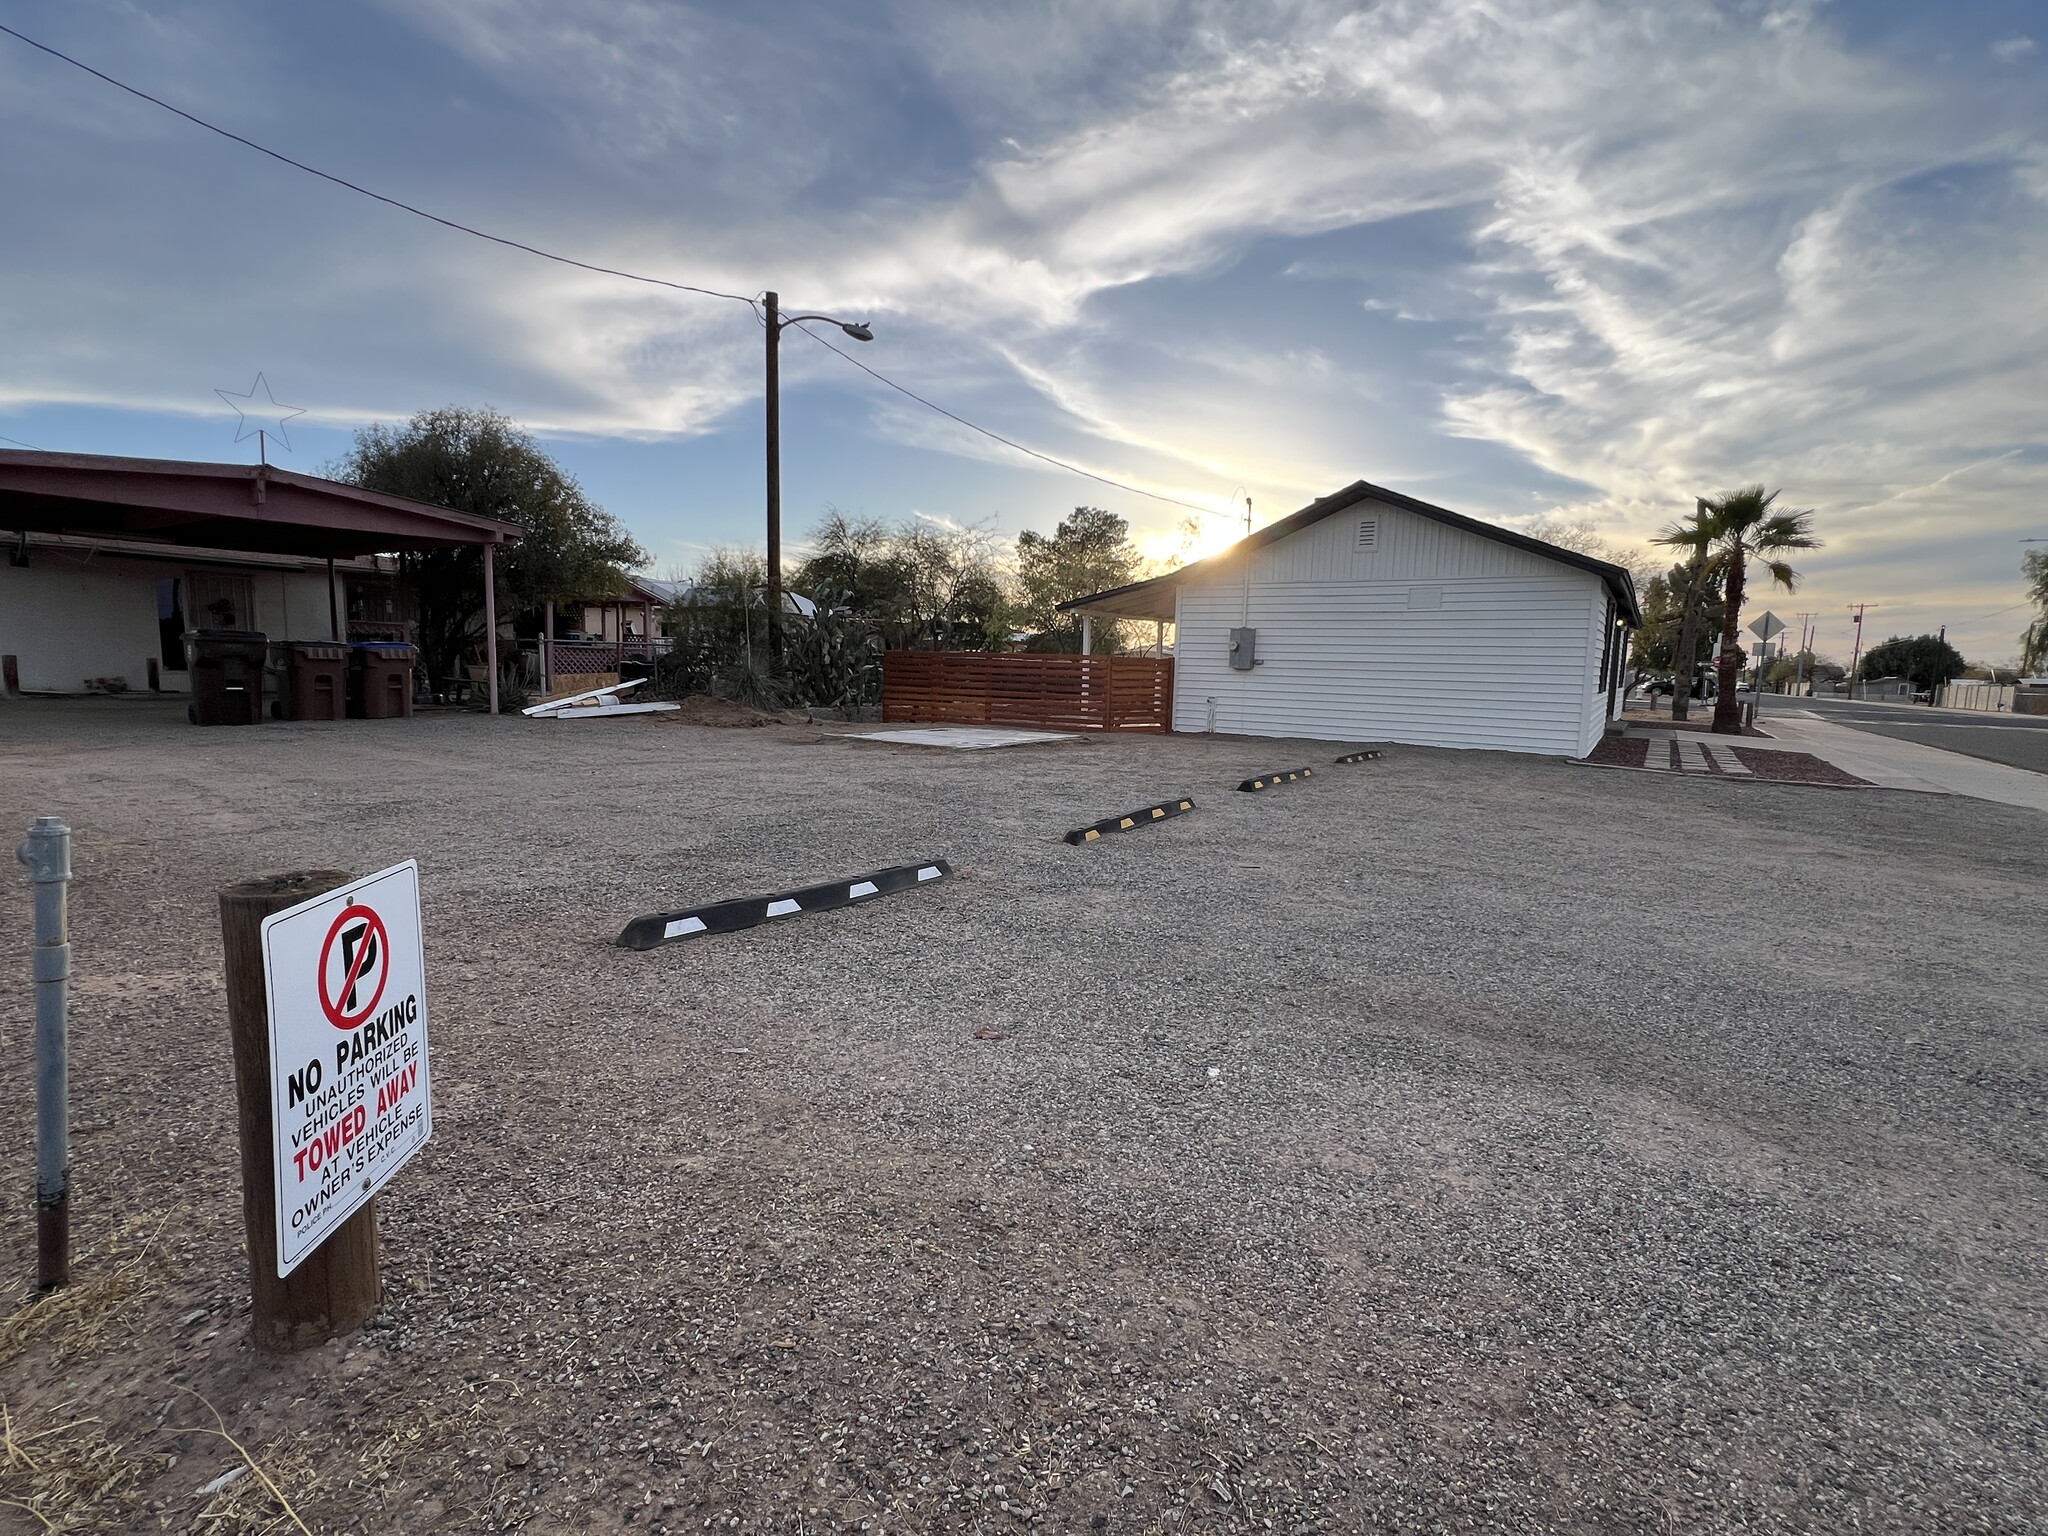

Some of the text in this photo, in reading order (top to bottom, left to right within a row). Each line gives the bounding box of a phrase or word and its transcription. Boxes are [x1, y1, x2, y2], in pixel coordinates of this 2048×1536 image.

[341, 923, 377, 1012] P
[288, 994, 417, 1109] NO PARKING
[291, 1041, 418, 1148] VEHICLES WILL BE
[305, 1033, 408, 1117] UNAUTHORIZED
[291, 1156, 364, 1228] OWNER'S
[368, 1103, 422, 1163] EXPENSE
[293, 1060, 417, 1183] TOWED AWAY
[321, 1156, 340, 1184] AT
[346, 1103, 402, 1160] VEHICLE
[297, 1212, 321, 1238] POLICE
